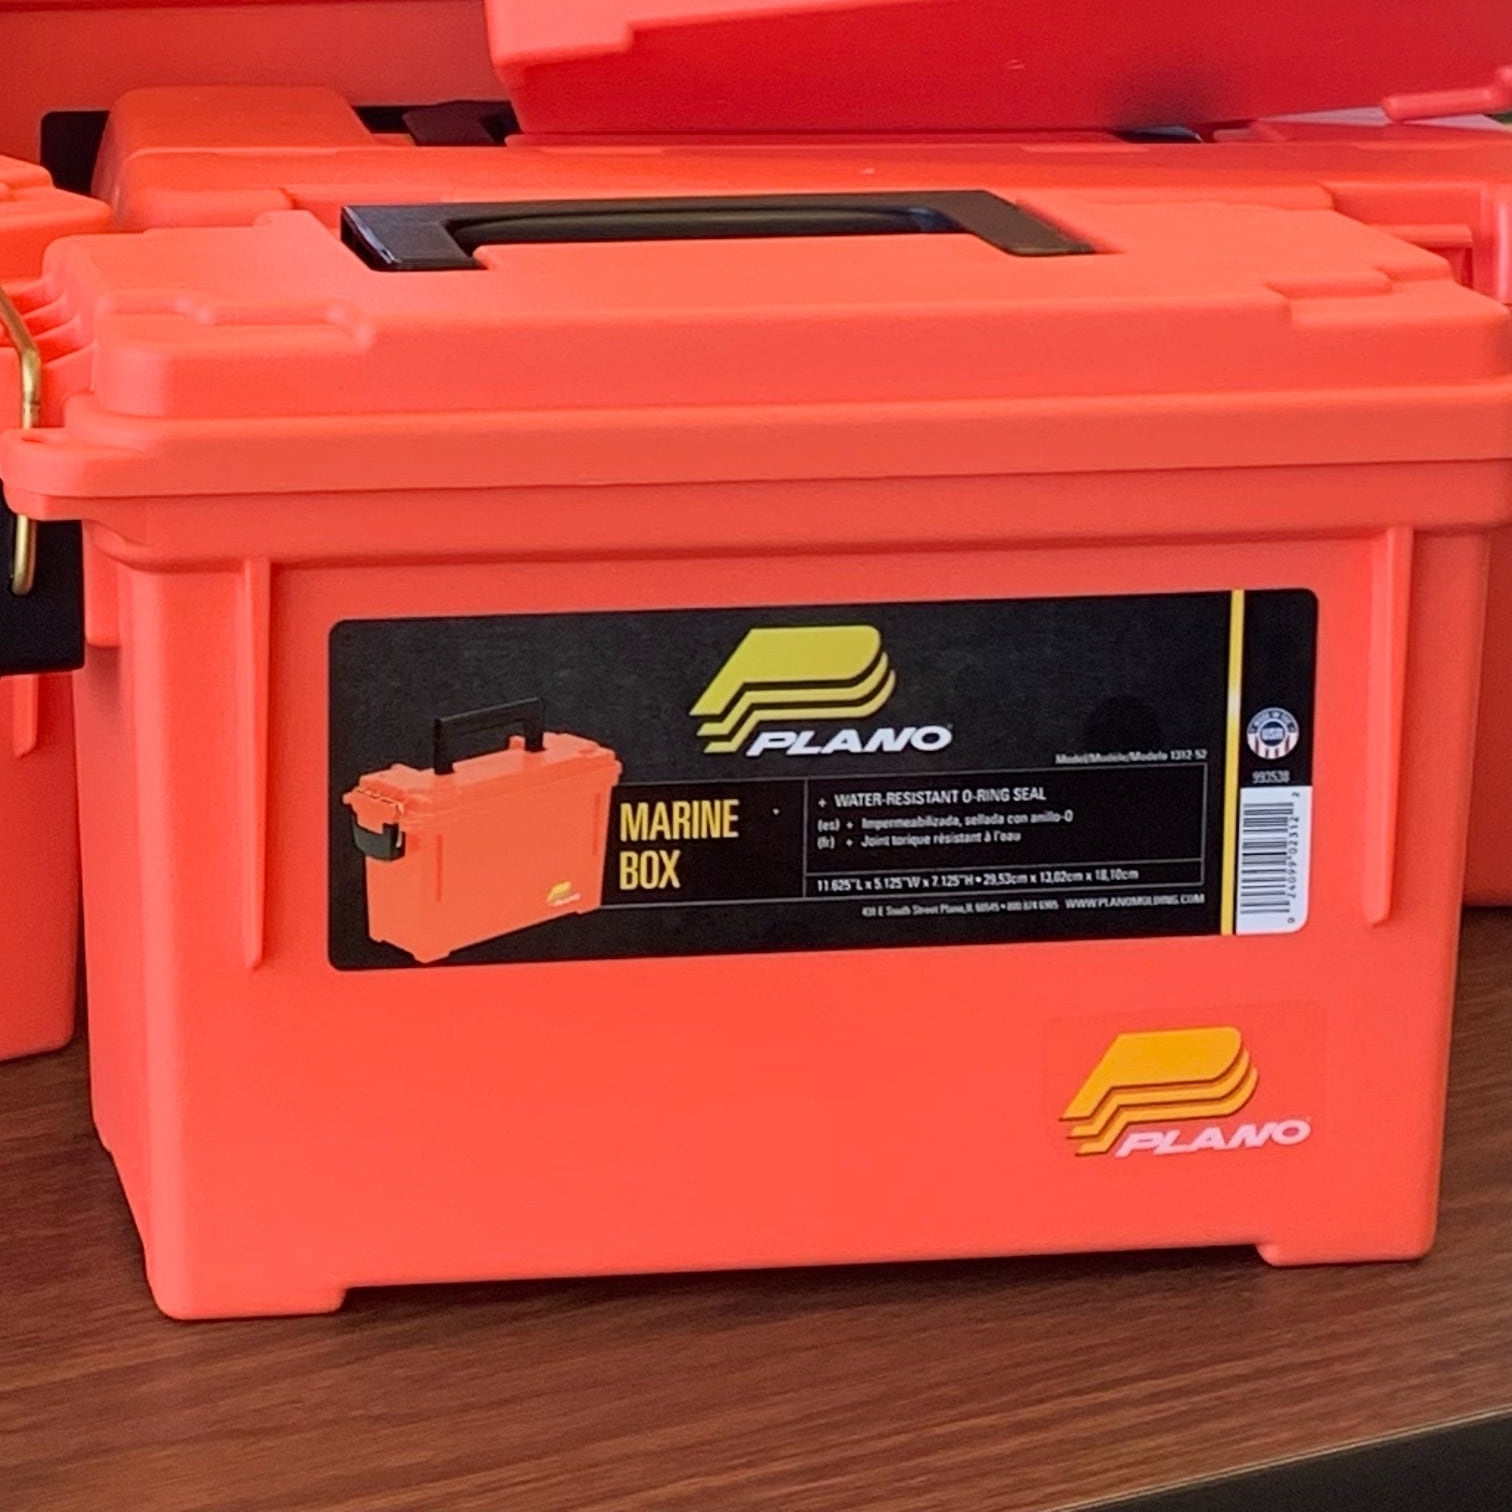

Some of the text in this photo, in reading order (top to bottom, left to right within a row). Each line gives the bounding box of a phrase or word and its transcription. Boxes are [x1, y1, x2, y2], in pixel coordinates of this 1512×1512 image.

[746, 726, 952, 757] PLANO
[834, 787, 1046, 807] WATER-RESISTANT O-RING SEAL
[620, 799, 739, 841] MARINE
[619, 850, 681, 890] BOX
[1114, 1119, 1311, 1157] PLANO
